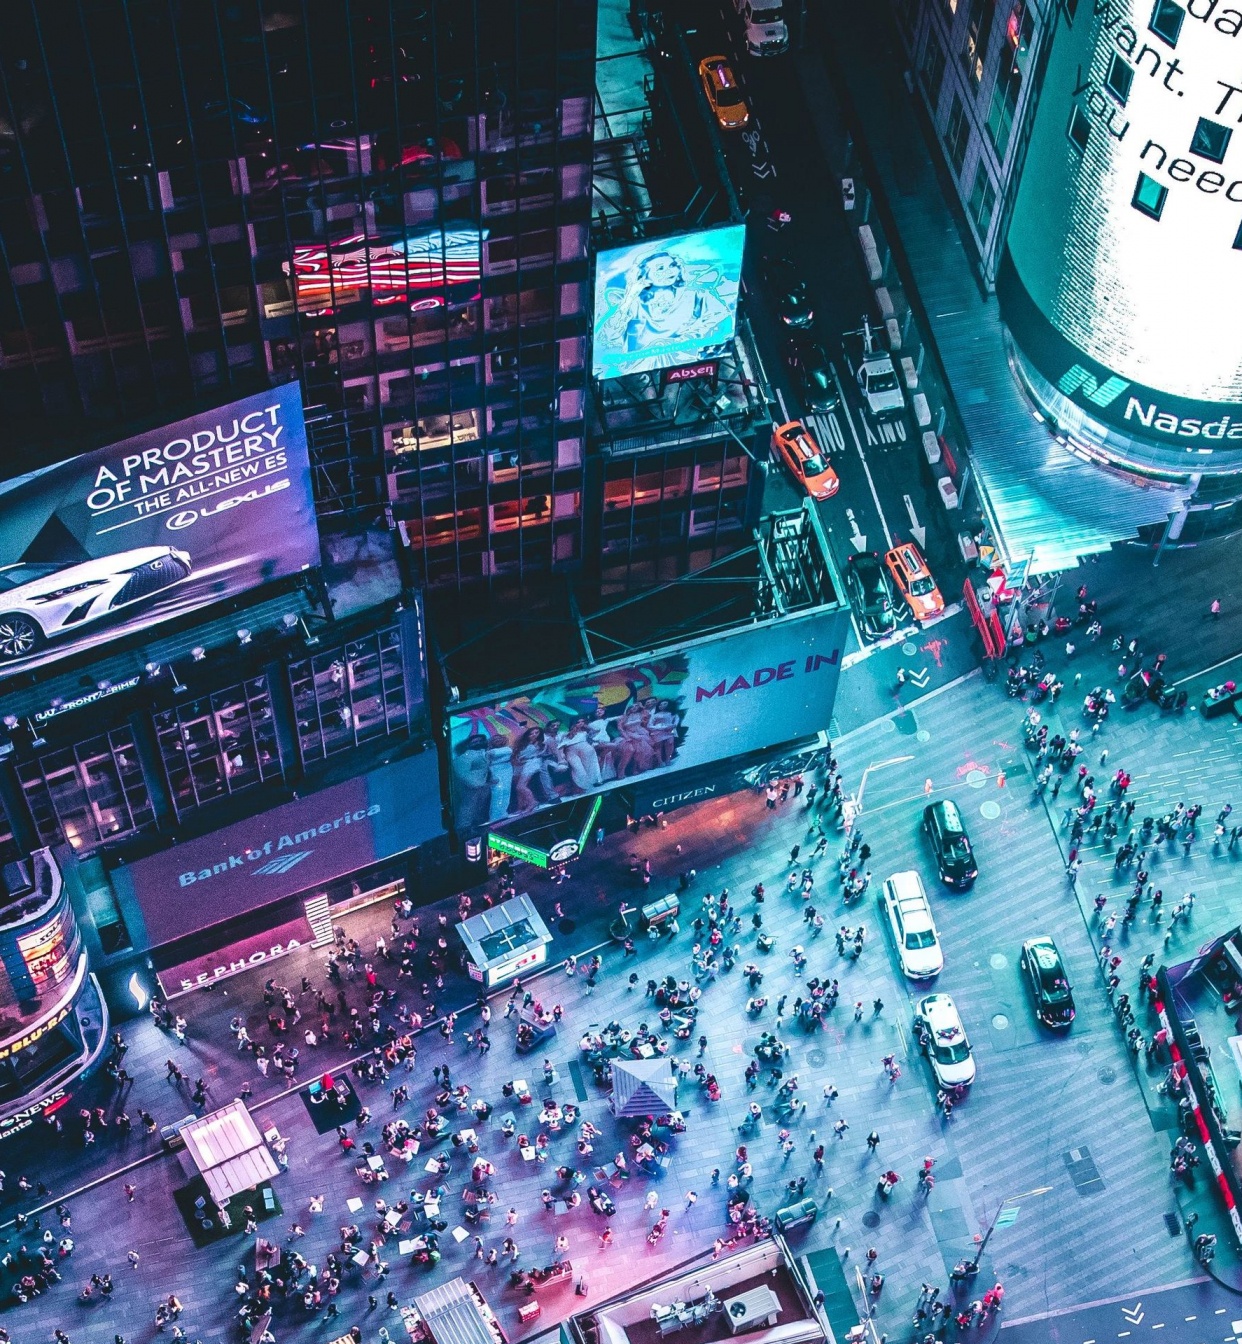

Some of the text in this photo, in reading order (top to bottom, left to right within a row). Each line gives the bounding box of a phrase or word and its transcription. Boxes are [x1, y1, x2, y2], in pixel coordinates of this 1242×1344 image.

[1071, 63, 1131, 142] You
[669, 366, 714, 380] Absen
[94, 403, 281, 488] A PRODUCT
[800, 412, 845, 454] ONL
[86, 426, 284, 510] OF MASTERY
[134, 452, 287, 515] THE ALL-NEW ES
[201, 478, 291, 517] LEXUS
[695, 648, 839, 703] MADE IN
[652, 784, 716, 808] CITIZEN
[178, 804, 381, 888] Bank of America
[180, 939, 301, 991] SEPHORA
[15, 1088, 65, 1123] NEWS
